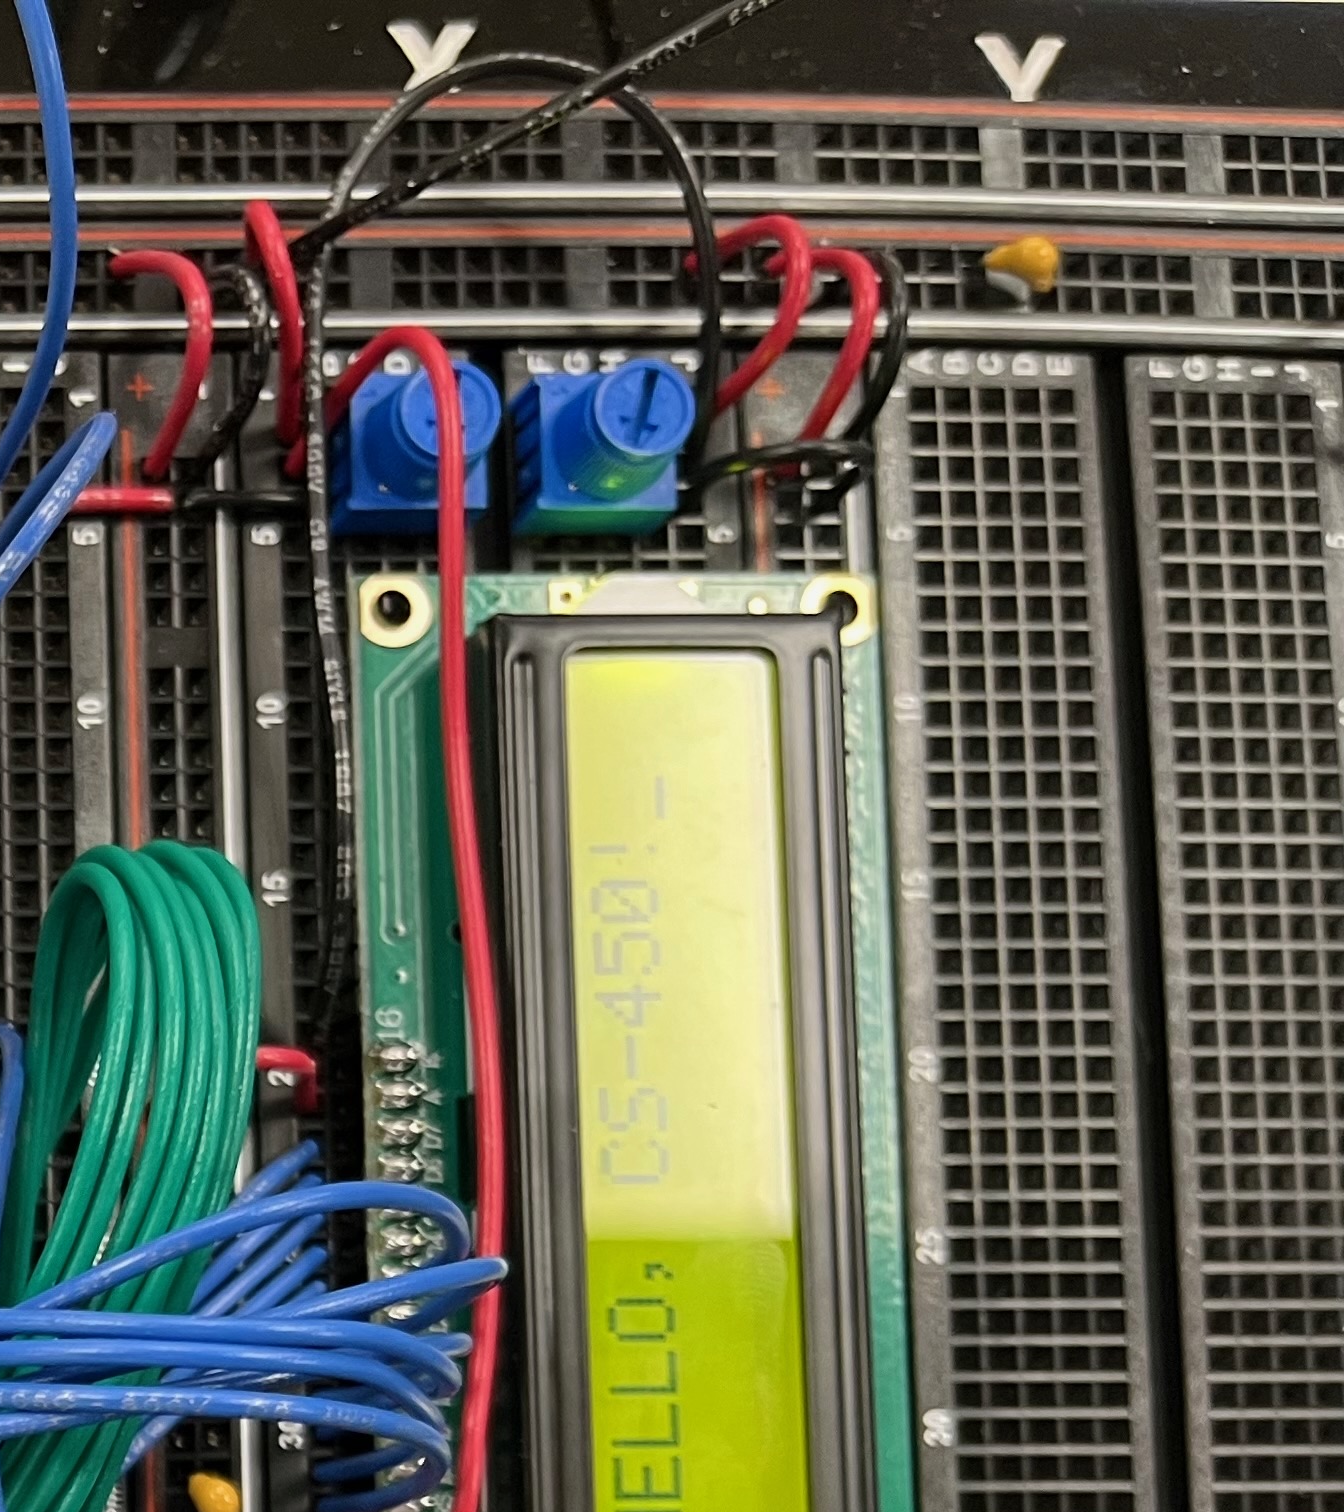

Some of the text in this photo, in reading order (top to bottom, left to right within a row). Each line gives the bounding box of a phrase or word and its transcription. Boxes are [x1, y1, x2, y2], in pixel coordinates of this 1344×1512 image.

[77, 692, 107, 730] 10
[255, 692, 289, 730] 10
[260, 868, 291, 907] 15
[375, 1006, 405, 1041] 16
